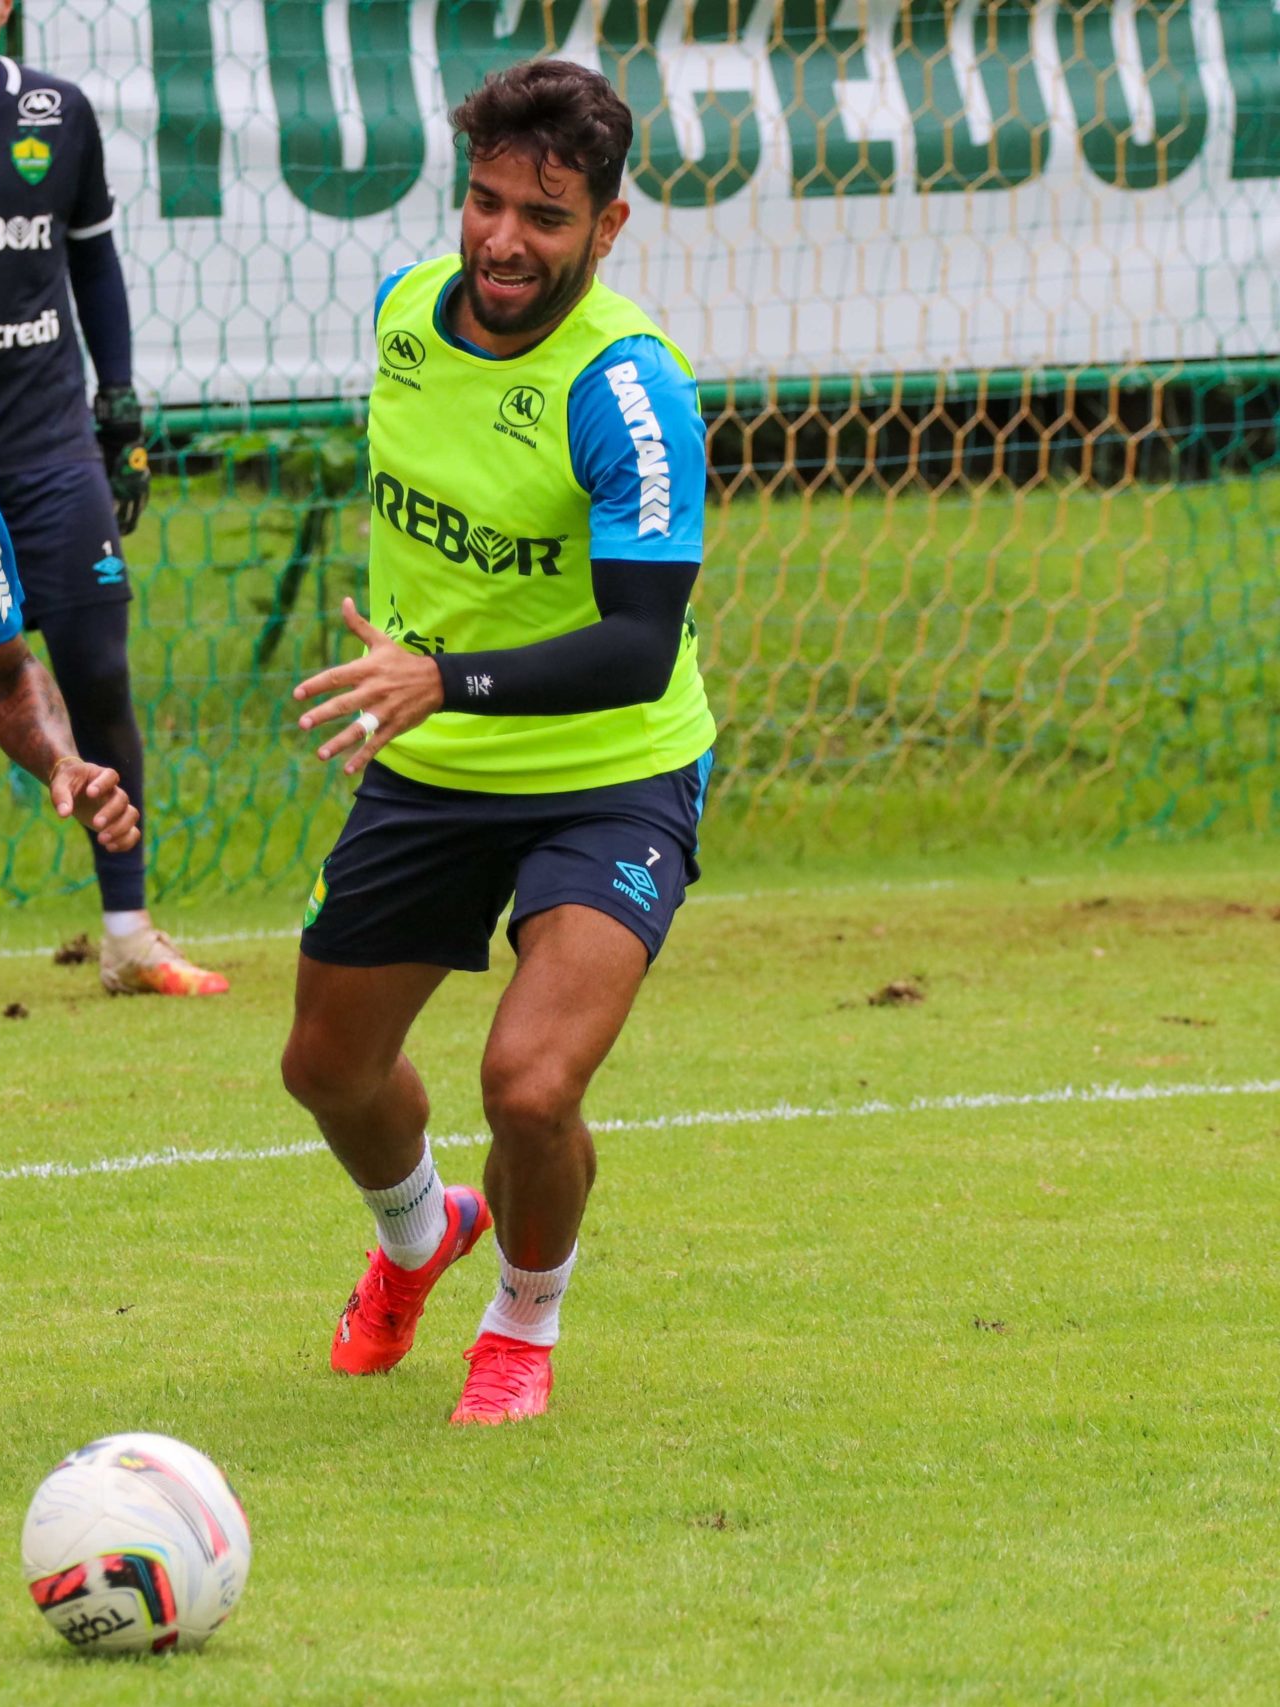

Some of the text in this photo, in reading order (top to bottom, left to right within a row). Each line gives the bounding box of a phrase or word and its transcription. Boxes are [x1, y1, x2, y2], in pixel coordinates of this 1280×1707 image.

[604, 361, 670, 536] RAYTAK
[371, 472, 562, 576] REBOR
[646, 846, 661, 867] 7
[612, 878, 651, 911] umbro
